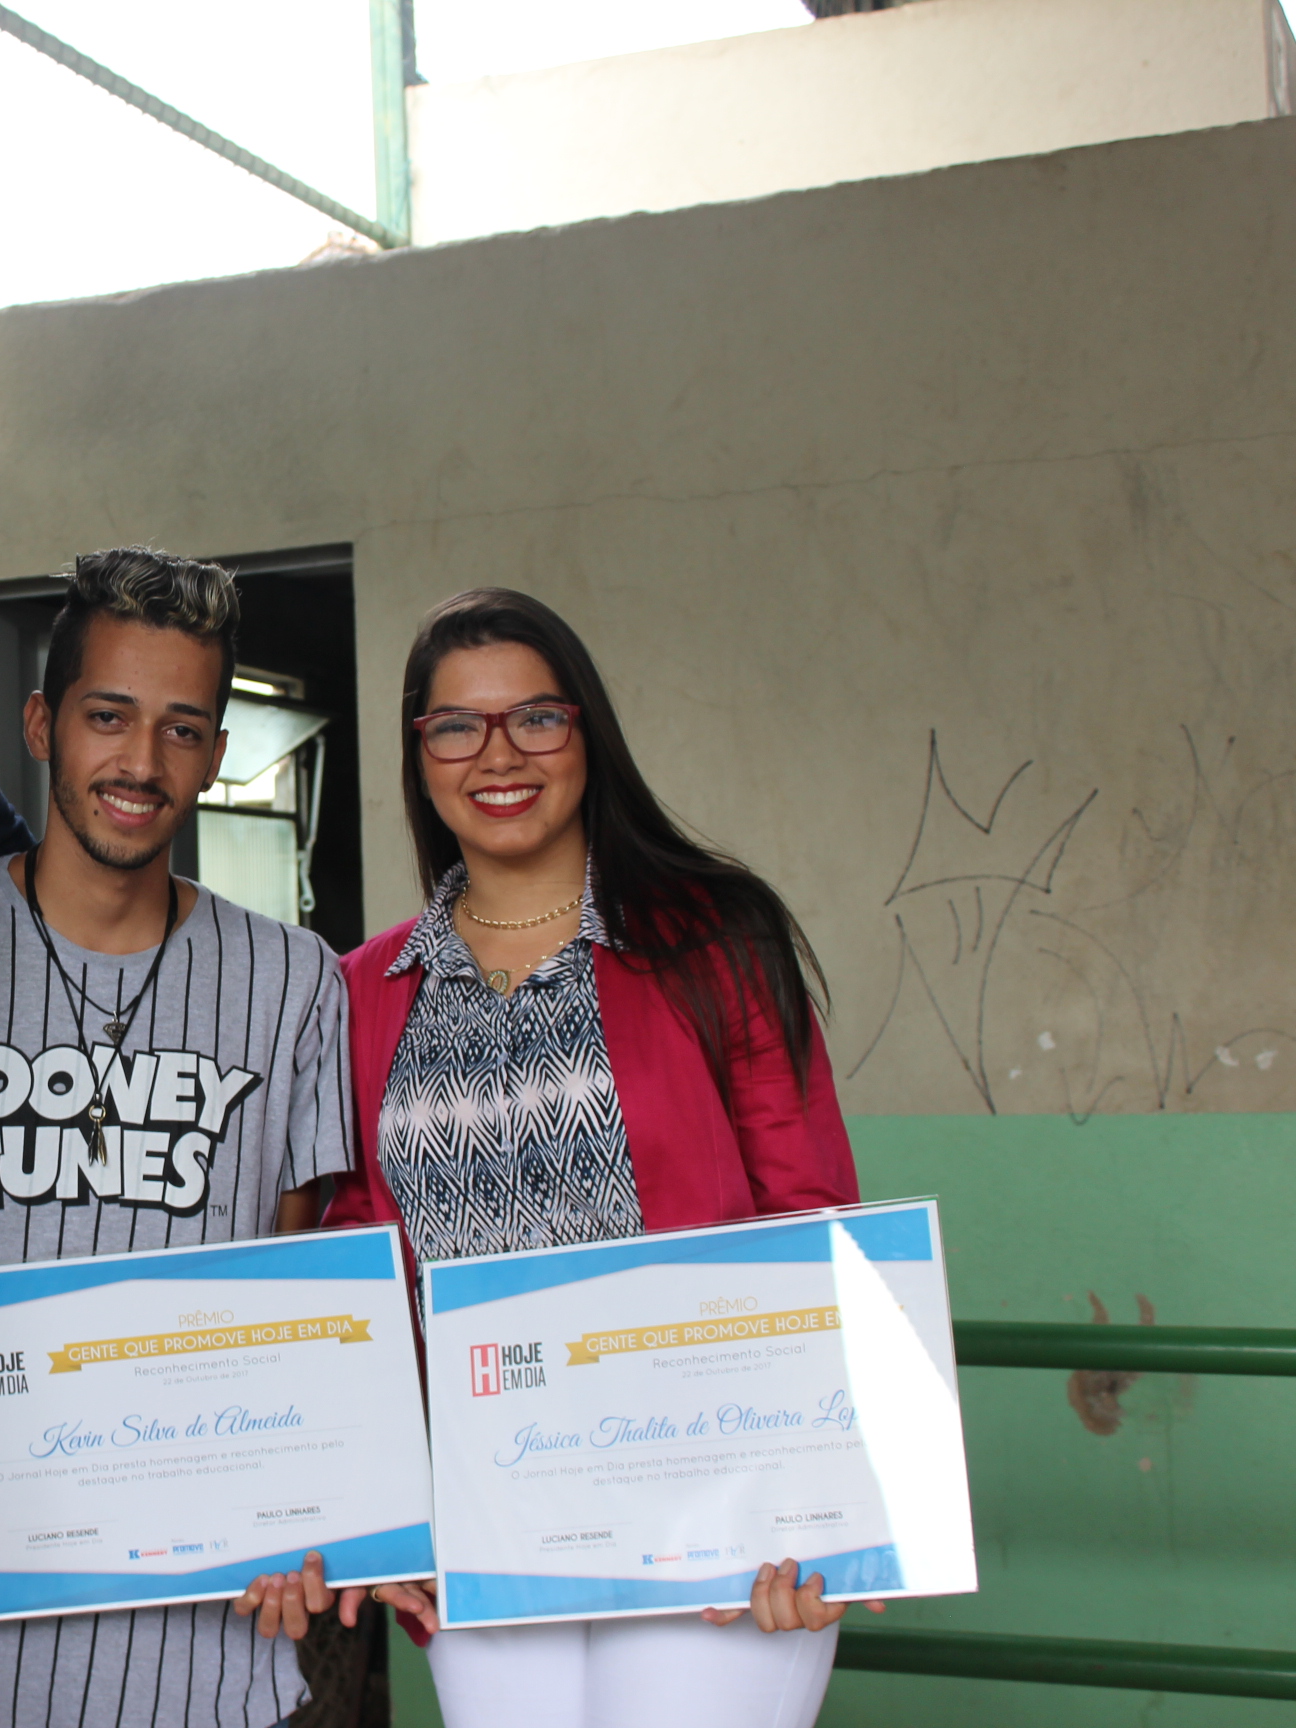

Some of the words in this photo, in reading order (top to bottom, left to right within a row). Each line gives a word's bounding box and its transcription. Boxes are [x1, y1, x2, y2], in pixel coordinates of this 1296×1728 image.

[210, 1205, 228, 1217] TM
[699, 1296, 758, 1316] PRÊMIO
[178, 1309, 234, 1328] PRÊMIO
[68, 1343, 118, 1362] GENTE
[124, 1340, 158, 1357] QUE
[164, 1330, 247, 1351] PROMOVE
[252, 1325, 293, 1342] HOJE
[297, 1323, 321, 1337] EM
[327, 1319, 353, 1334] DIA
[586, 1333, 637, 1352] GENTE
[643, 1329, 678, 1347] QUE
[684, 1319, 770, 1342] PROMOVE
[776, 1313, 819, 1332] HOJE
[134, 1358, 239, 1377] Reconhecimento
[243, 1353, 281, 1366] Social
[502, 1342, 543, 1367] HOJE
[653, 1348, 762, 1369] Reconhecimento
[765, 1343, 806, 1356] Social
[29, 1419, 105, 1459] Kevin
[111, 1414, 178, 1448] Silva
[185, 1414, 208, 1437] de
[214, 1405, 304, 1436] Almeida
[494, 1422, 583, 1468] Jéssica
[589, 1416, 679, 1449] Thalita
[686, 1411, 710, 1437] de
[717, 1403, 804, 1436] Oliveira
[812, 1389, 858, 1432] Lop
[8, 1469, 42, 1482] Jornal
[45, 1466, 69, 1480] Hoje
[72, 1465, 88, 1474] em
[92, 1463, 109, 1473] Dia
[113, 1459, 146, 1473] presta
[150, 1452, 218, 1468] homenagem
[231, 1441, 318, 1459] reconhecimento
[321, 1438, 345, 1452] pelo
[511, 1471, 520, 1480] O
[523, 1467, 557, 1480] Jornal
[560, 1464, 584, 1478] Hoje
[587, 1463, 604, 1473] em
[607, 1461, 625, 1471] Dia
[628, 1457, 663, 1472] presta
[666, 1450, 737, 1466] homenagem
[750, 1440, 842, 1458] reconhecimento
[78, 1473, 128, 1487] destaque
[131, 1472, 145, 1481] no
[148, 1465, 193, 1480] trabalho
[593, 1473, 644, 1487] destaque
[647, 1471, 661, 1481] no
[664, 1465, 710, 1480] trabalho
[256, 1509, 283, 1520] PAULO
[285, 1505, 321, 1517] LINHARES
[775, 1514, 803, 1525] PAULO
[805, 1511, 843, 1522] LINHARES
[28, 1531, 64, 1543] LUCIANO
[66, 1527, 99, 1538] RESENDE
[542, 1533, 578, 1544] LUCIANO
[580, 1530, 613, 1541] RESENDE
